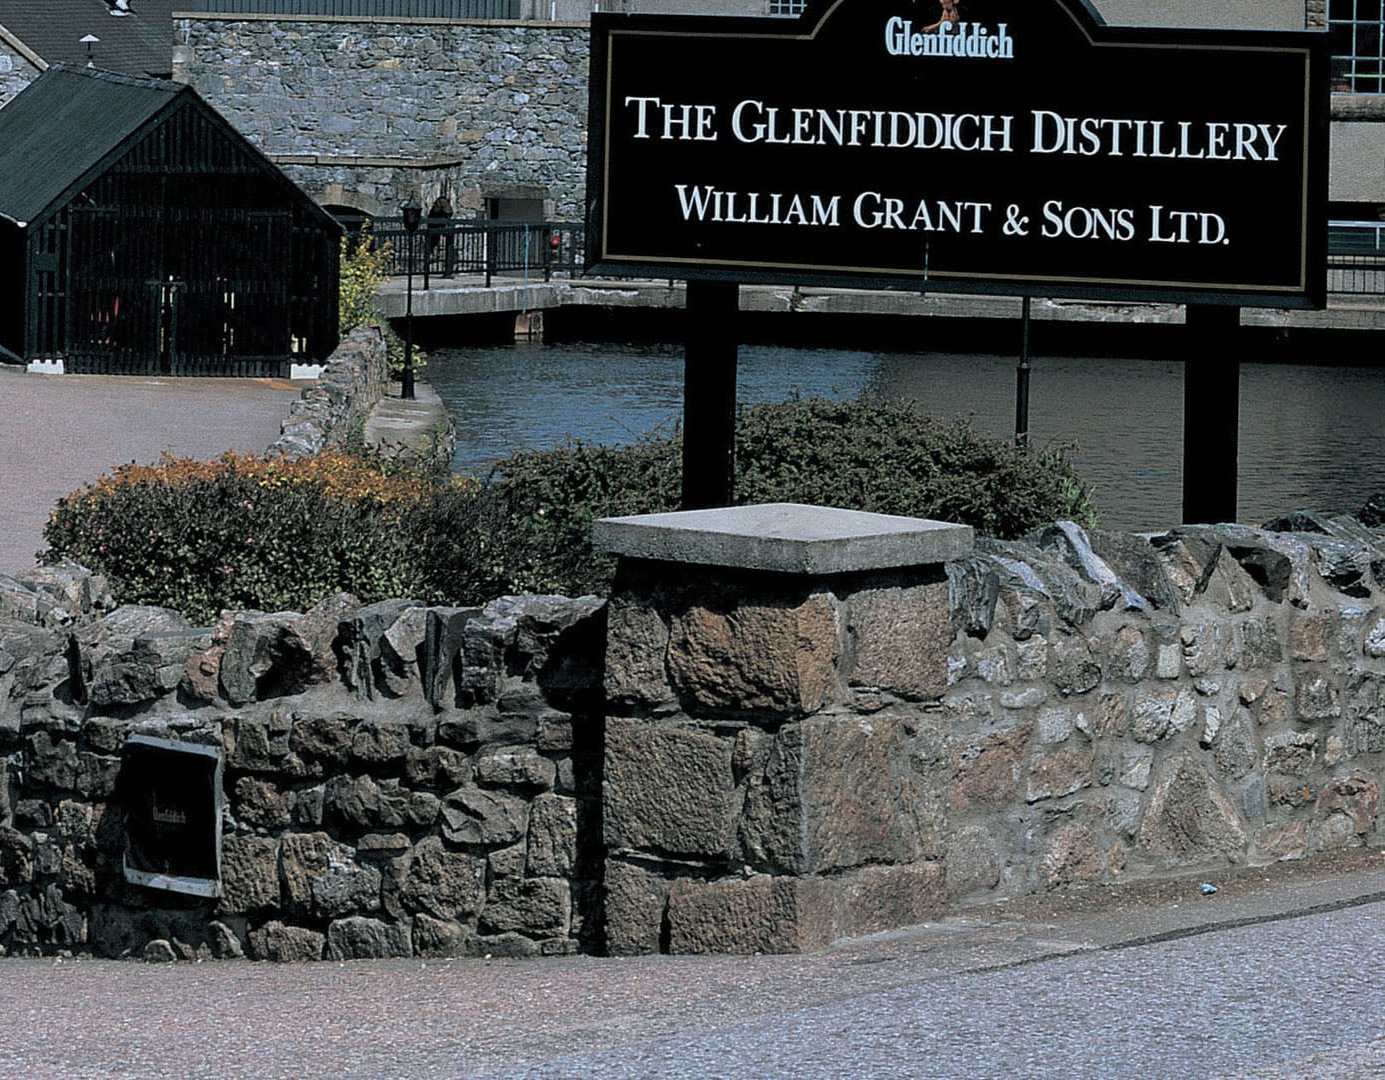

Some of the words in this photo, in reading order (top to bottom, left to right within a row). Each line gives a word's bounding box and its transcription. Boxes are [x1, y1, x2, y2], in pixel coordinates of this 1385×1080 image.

[885, 16, 1014, 59] Glenfiddich
[624, 96, 718, 141] THE
[731, 99, 1013, 152] GLENFIDDICH
[1029, 110, 1288, 161] DISTILLERY
[674, 184, 841, 227] WILLIAM
[853, 191, 992, 234] GRANT
[1002, 203, 1030, 236] &
[1041, 200, 1135, 241] SONS
[1148, 205, 1230, 245] LTD.
